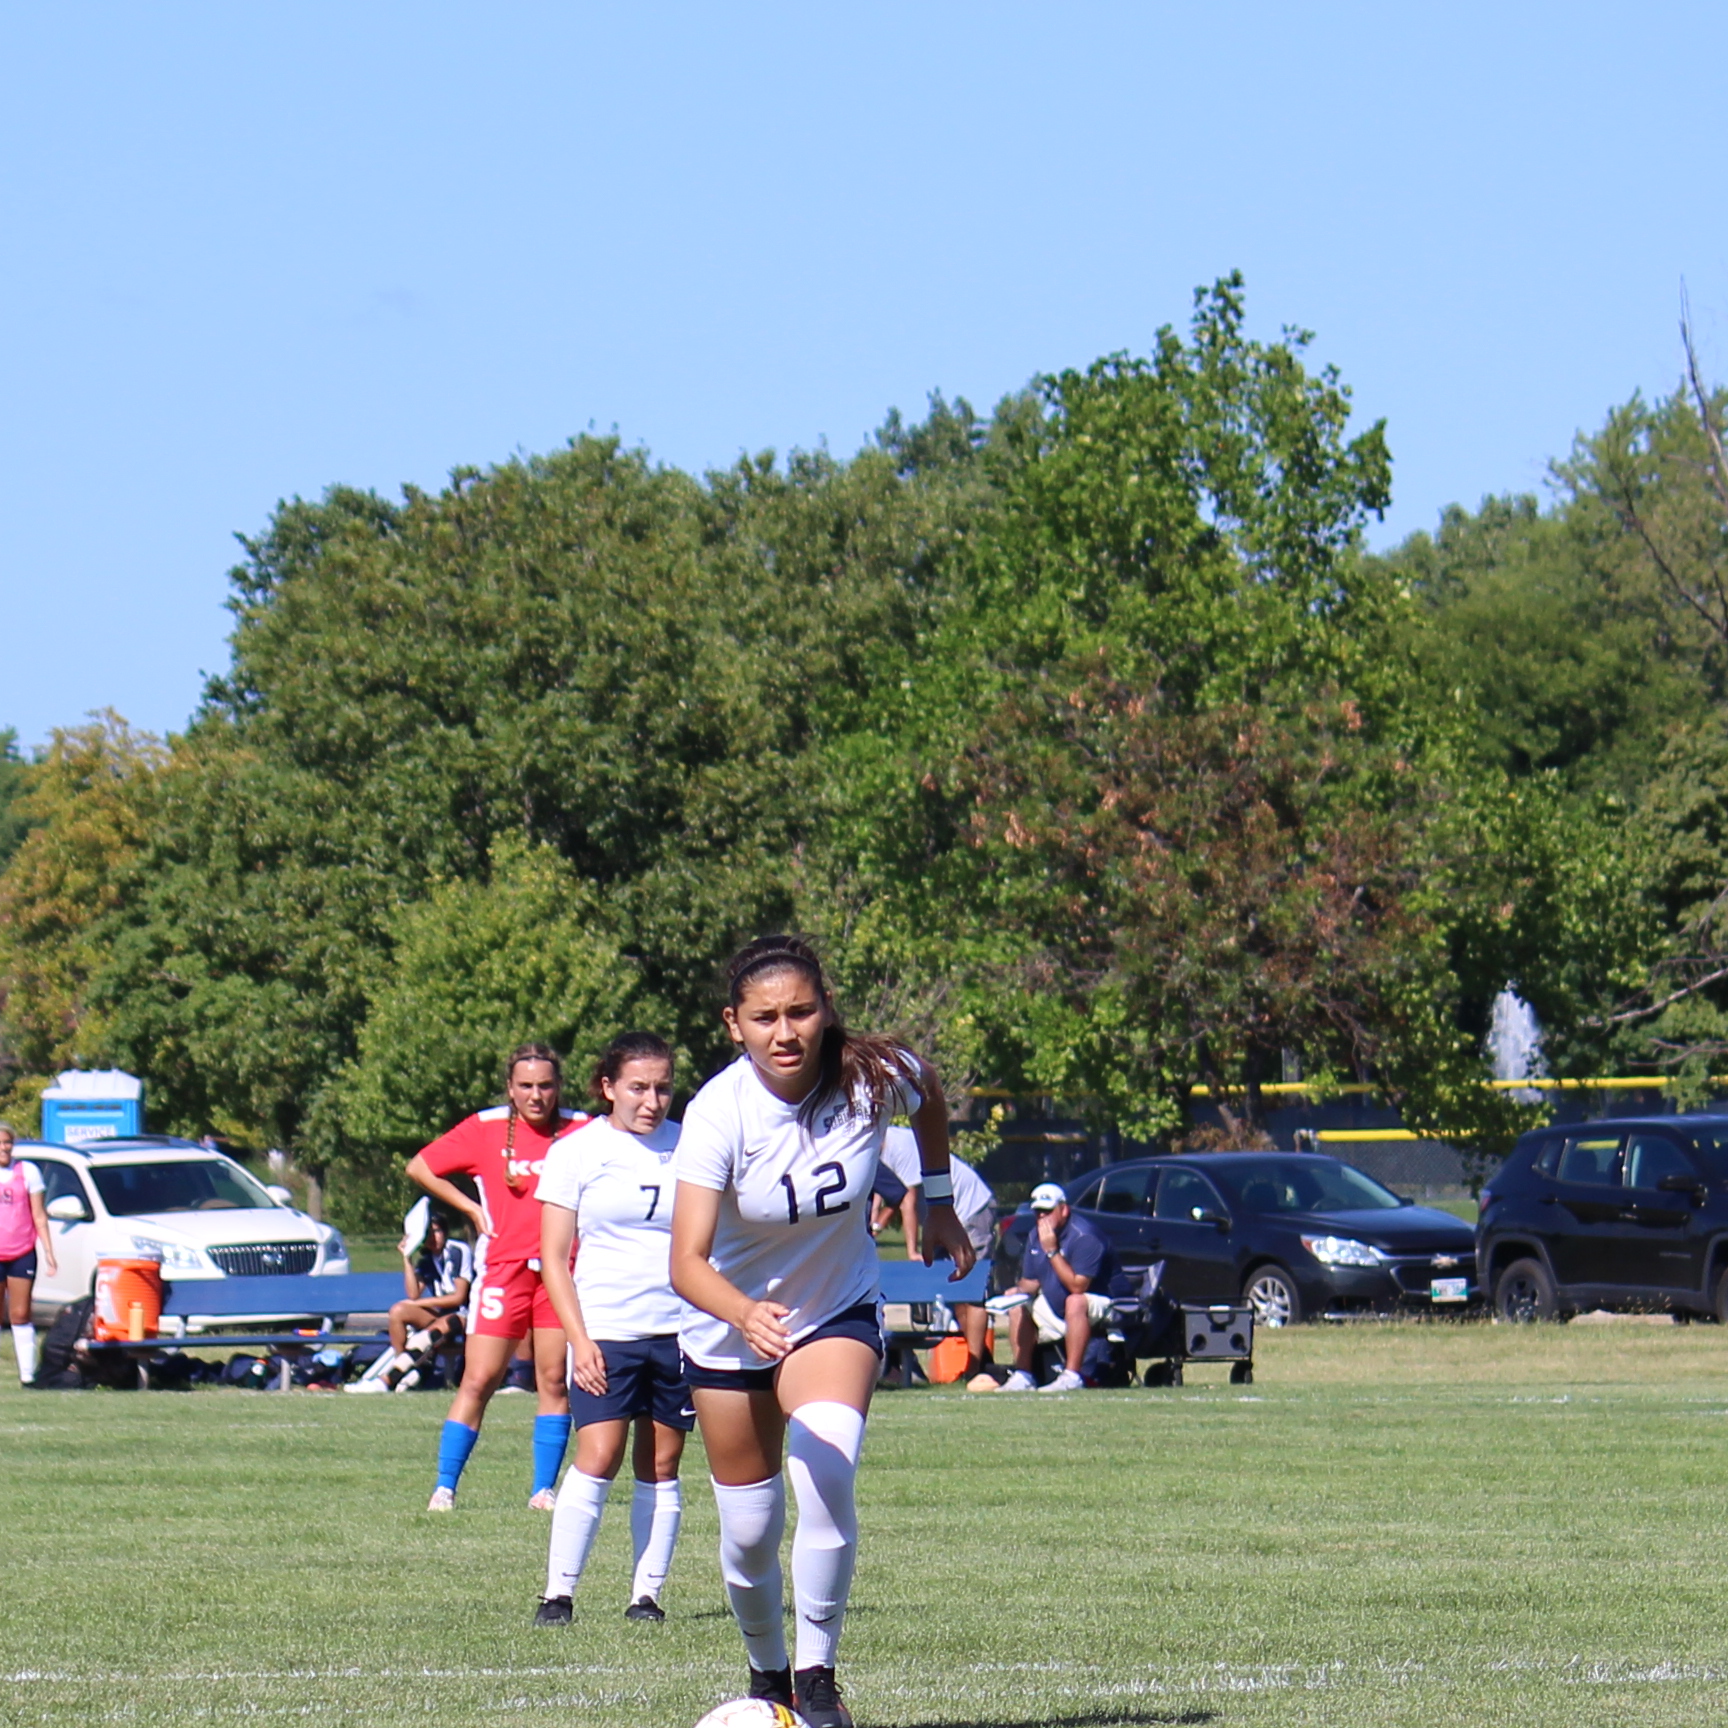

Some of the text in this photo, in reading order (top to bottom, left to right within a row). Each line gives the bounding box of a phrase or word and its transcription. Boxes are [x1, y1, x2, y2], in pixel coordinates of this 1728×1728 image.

[507, 1159, 547, 1176] KC
[639, 1184, 661, 1221] 7
[781, 1161, 850, 1225] 12
[481, 1287, 505, 1319] 5
